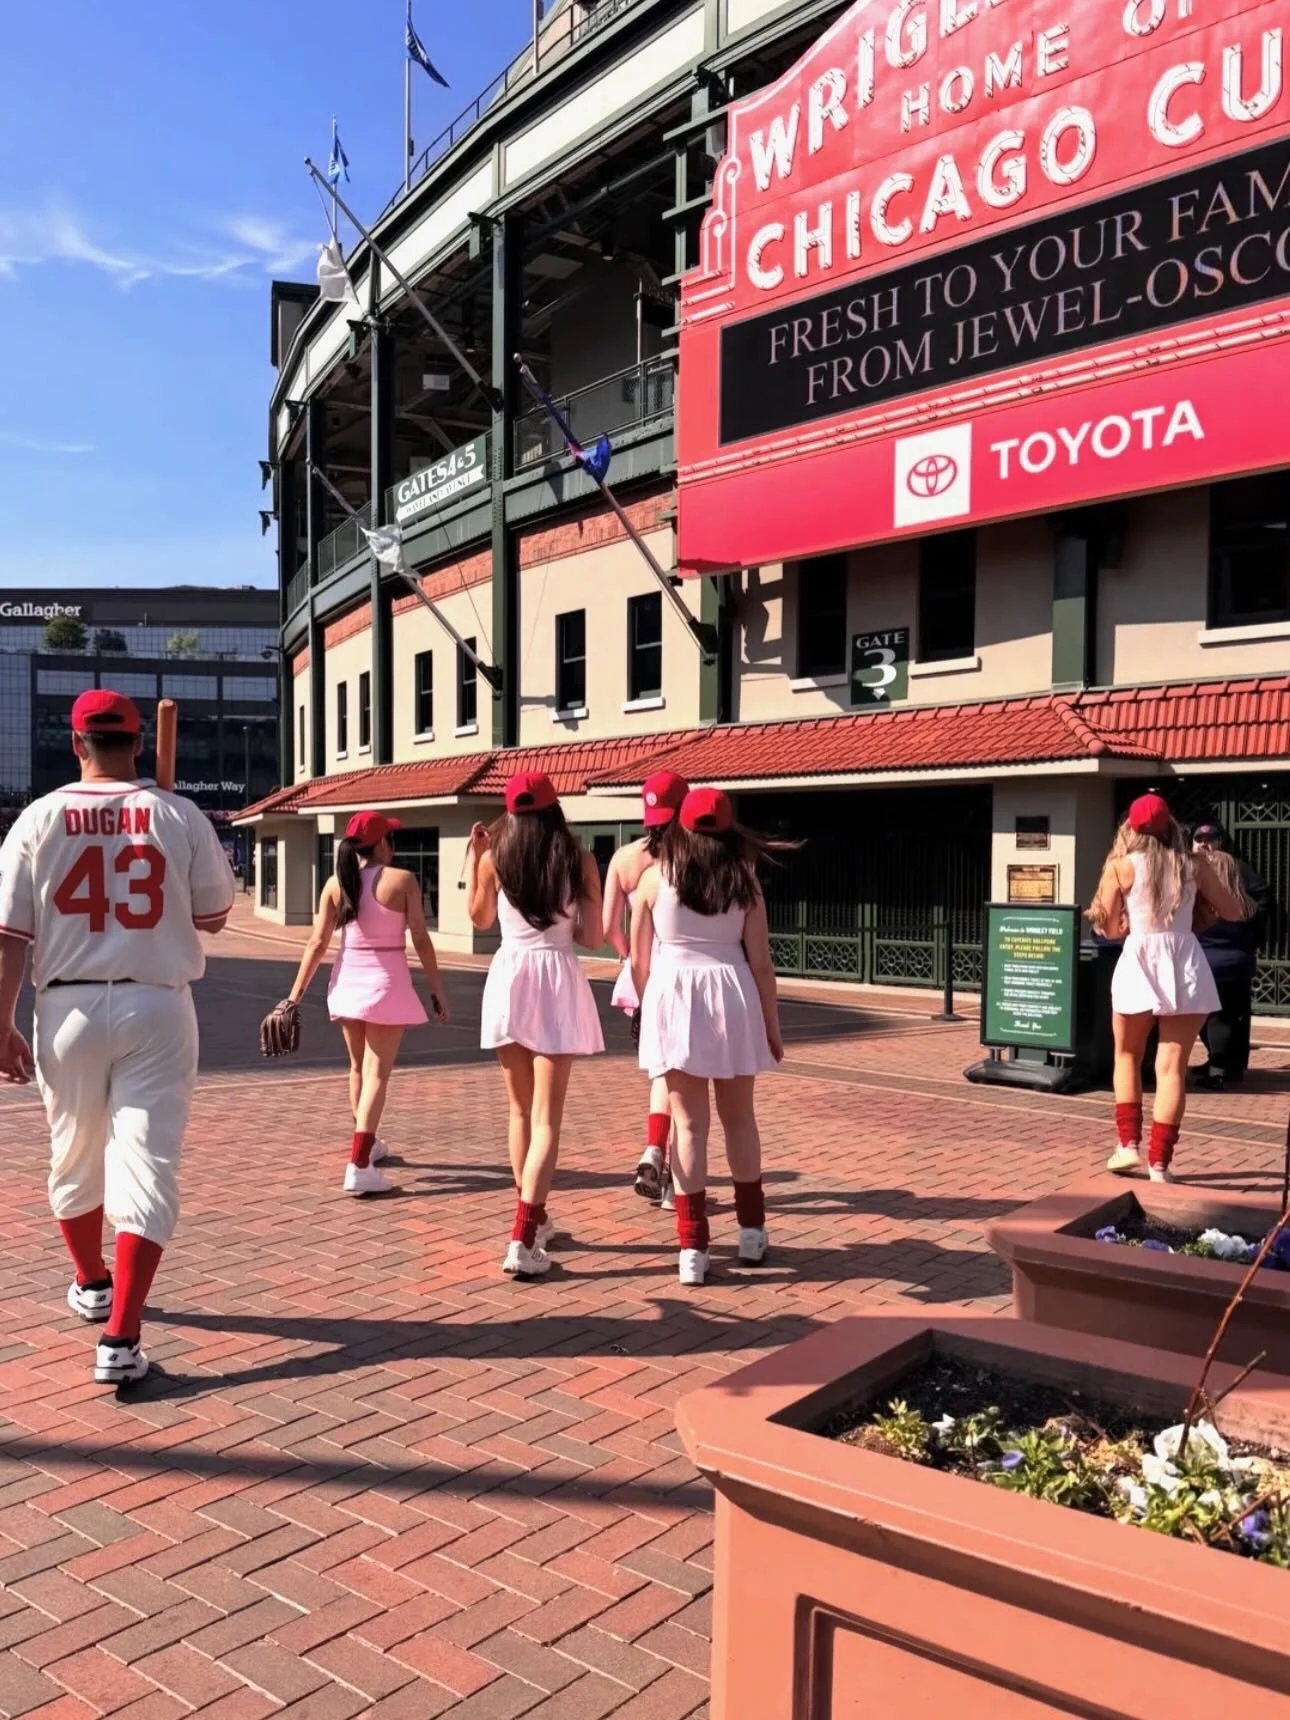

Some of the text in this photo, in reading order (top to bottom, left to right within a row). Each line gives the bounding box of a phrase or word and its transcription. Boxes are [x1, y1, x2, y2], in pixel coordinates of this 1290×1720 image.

[750, 0, 1008, 192] WRIGL
[901, 23, 1069, 133] HOME
[746, 105, 1097, 291] CHICAGO
[768, 286, 902, 365] FRESH
[914, 264, 978, 318] TO
[990, 210, 1151, 294] YOUR
[805, 329, 935, 406] FROM
[398, 461, 447, 503] GATES
[447, 454, 456, 476] 4
[465, 443, 476, 468] 5
[990, 399, 1205, 480] TOYOTA
[0, 601, 82, 620] Gallagher
[856, 631, 905, 649] GATE
[862, 648, 897, 688] 3
[64, 808, 152, 837] DUGAN
[173, 780, 246, 794] allagher Way
[53, 844, 167, 933] 43
